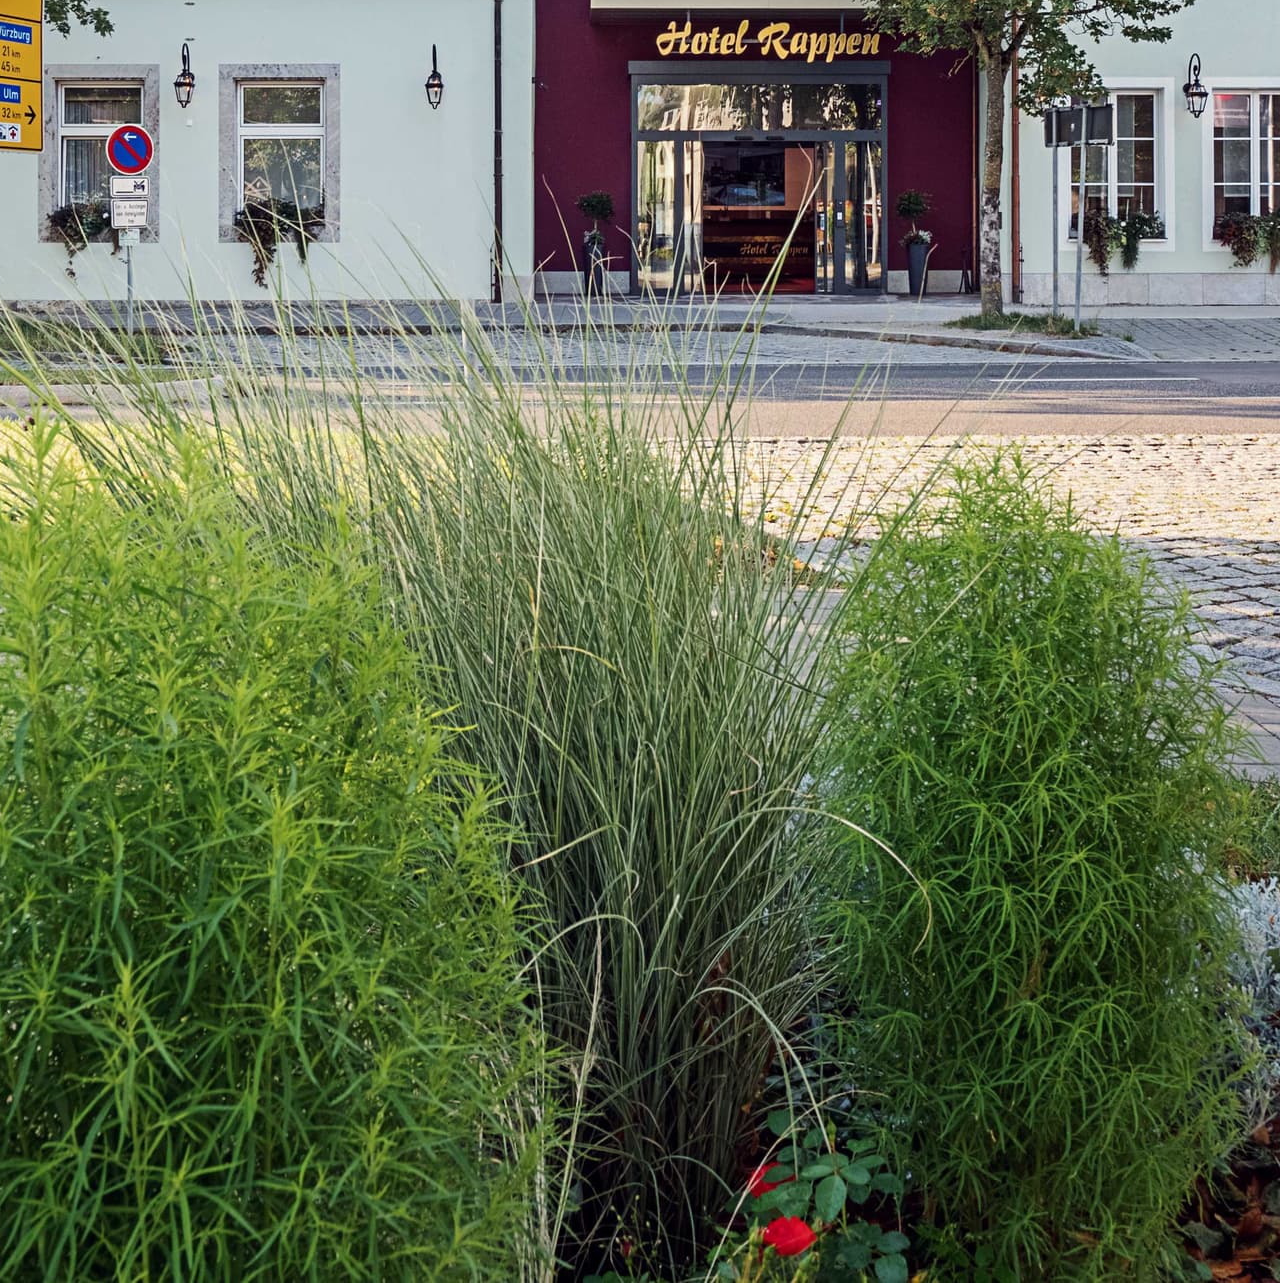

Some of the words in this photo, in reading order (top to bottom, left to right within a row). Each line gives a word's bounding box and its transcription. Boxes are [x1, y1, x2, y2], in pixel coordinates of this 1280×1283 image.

[656, 19, 750, 56] Hotel
[757, 21, 880, 63] Rappen
[2, 45, 10, 57] 21
[11, 50, 21, 58] km
[1, 60, 11, 72] 45
[11, 65, 21, 73] km
[3, 87, 19, 100] Ulm
[2, 107, 11, 118] 32
[740, 243, 768, 255] Hotel
